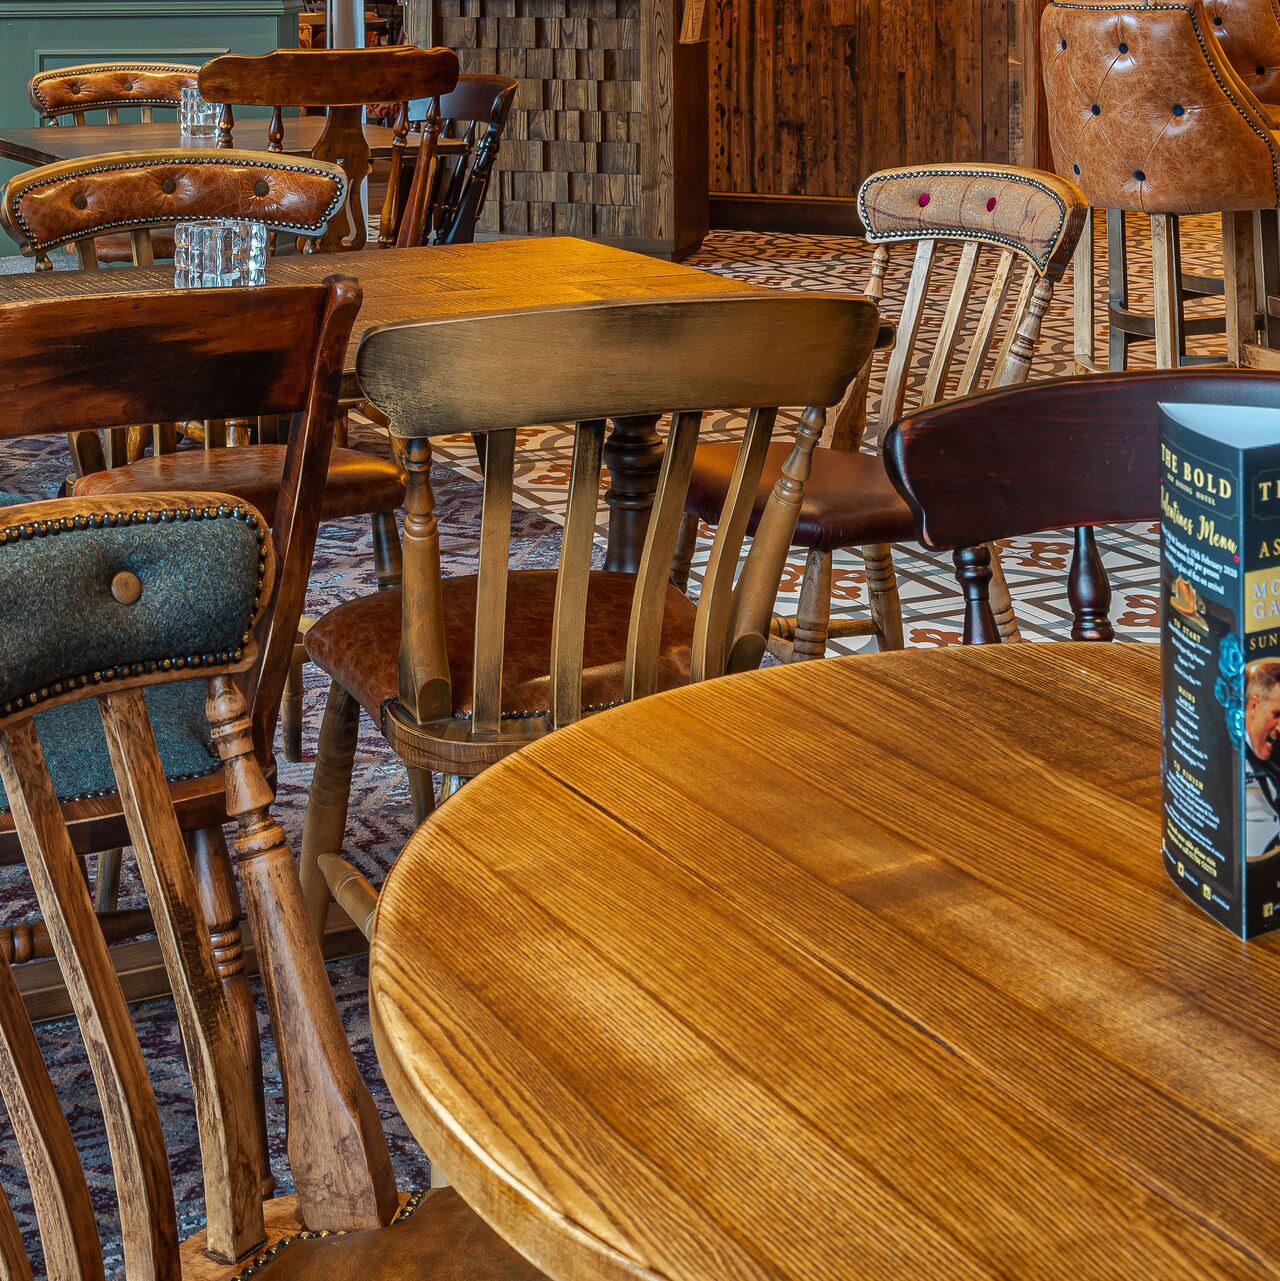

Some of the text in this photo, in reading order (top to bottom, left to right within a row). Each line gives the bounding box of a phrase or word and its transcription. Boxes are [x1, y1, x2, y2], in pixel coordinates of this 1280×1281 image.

[1161, 443, 1232, 499] THE BOLD
[1195, 491, 1216, 506] HOTEL
[1197, 515, 1237, 554] Menu
[1183, 626, 1201, 643] START
